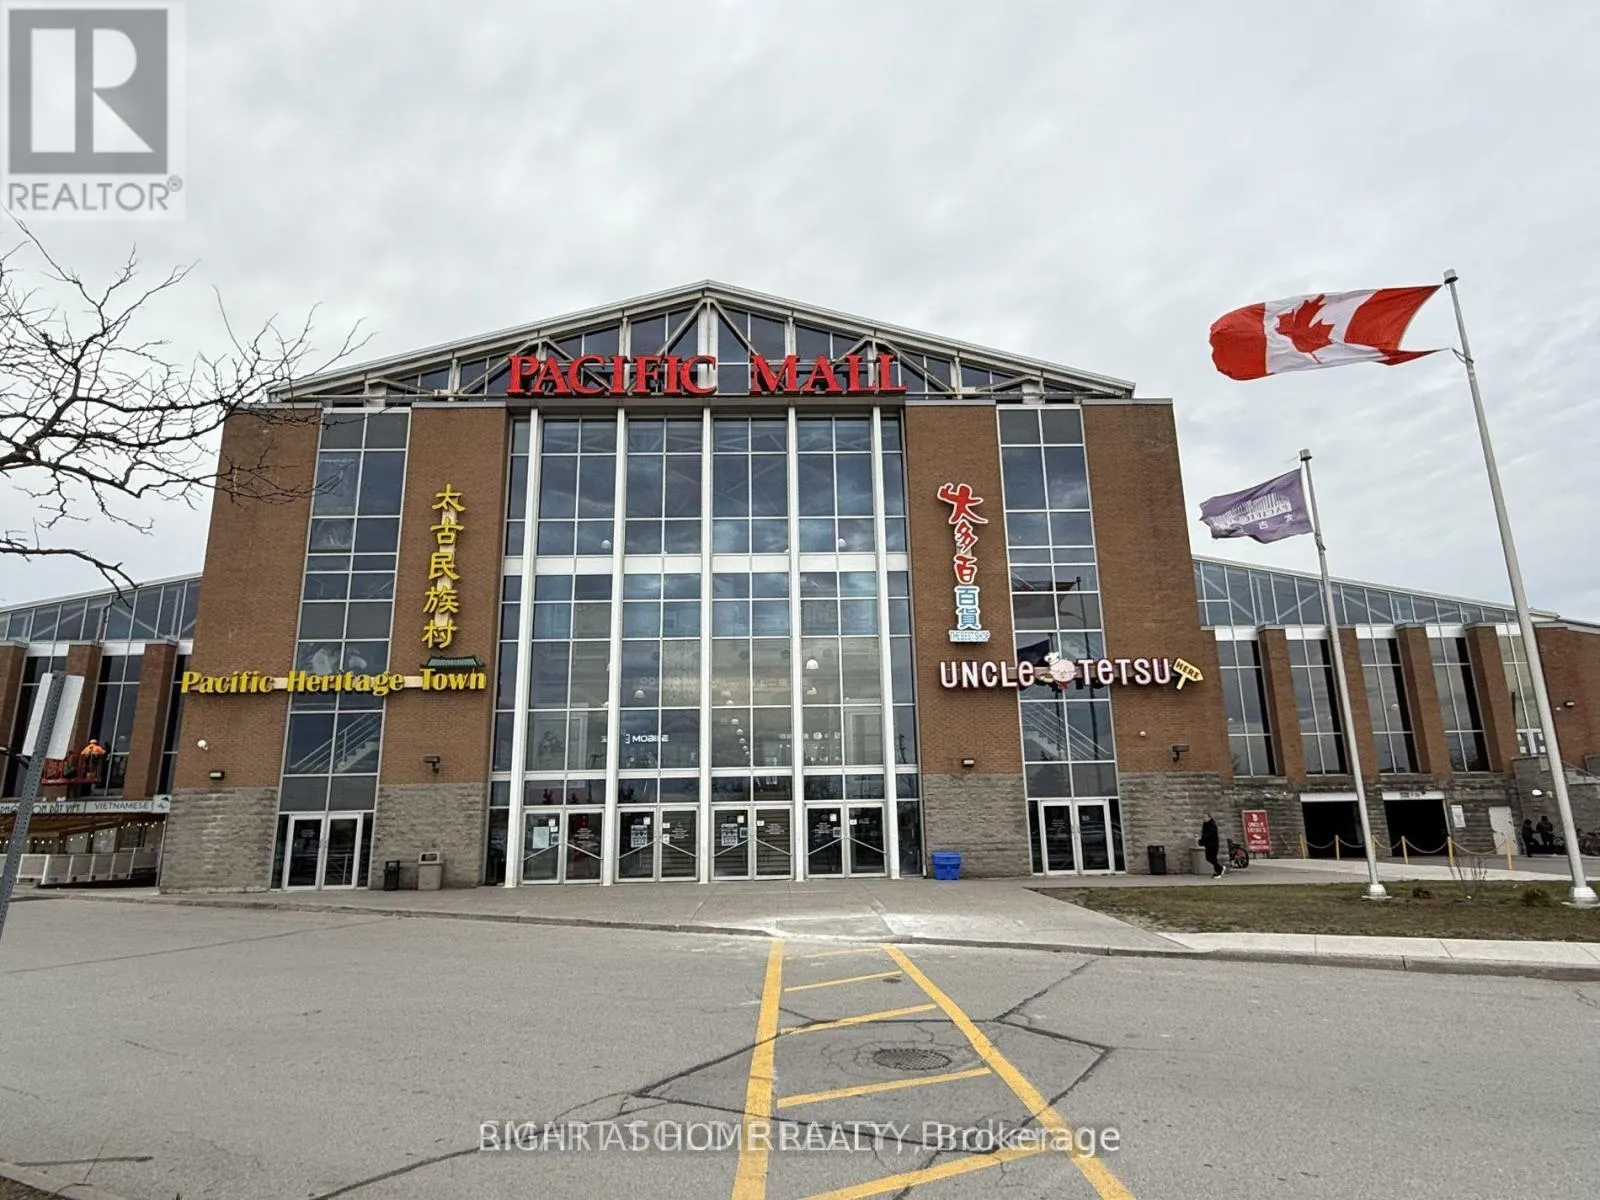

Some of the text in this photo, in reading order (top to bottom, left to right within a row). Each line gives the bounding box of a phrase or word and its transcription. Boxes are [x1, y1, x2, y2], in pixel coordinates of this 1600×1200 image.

[506, 352, 907, 396] PACIFIC MALL
[421, 483, 466, 650] 太古民族村
[180, 668, 487, 697] Pacific Heritage Town
[1175, 658, 1200, 681] HERE
[632, 734, 669, 743] MOBIE
[94, 801, 149, 811] VIETNAMESE
